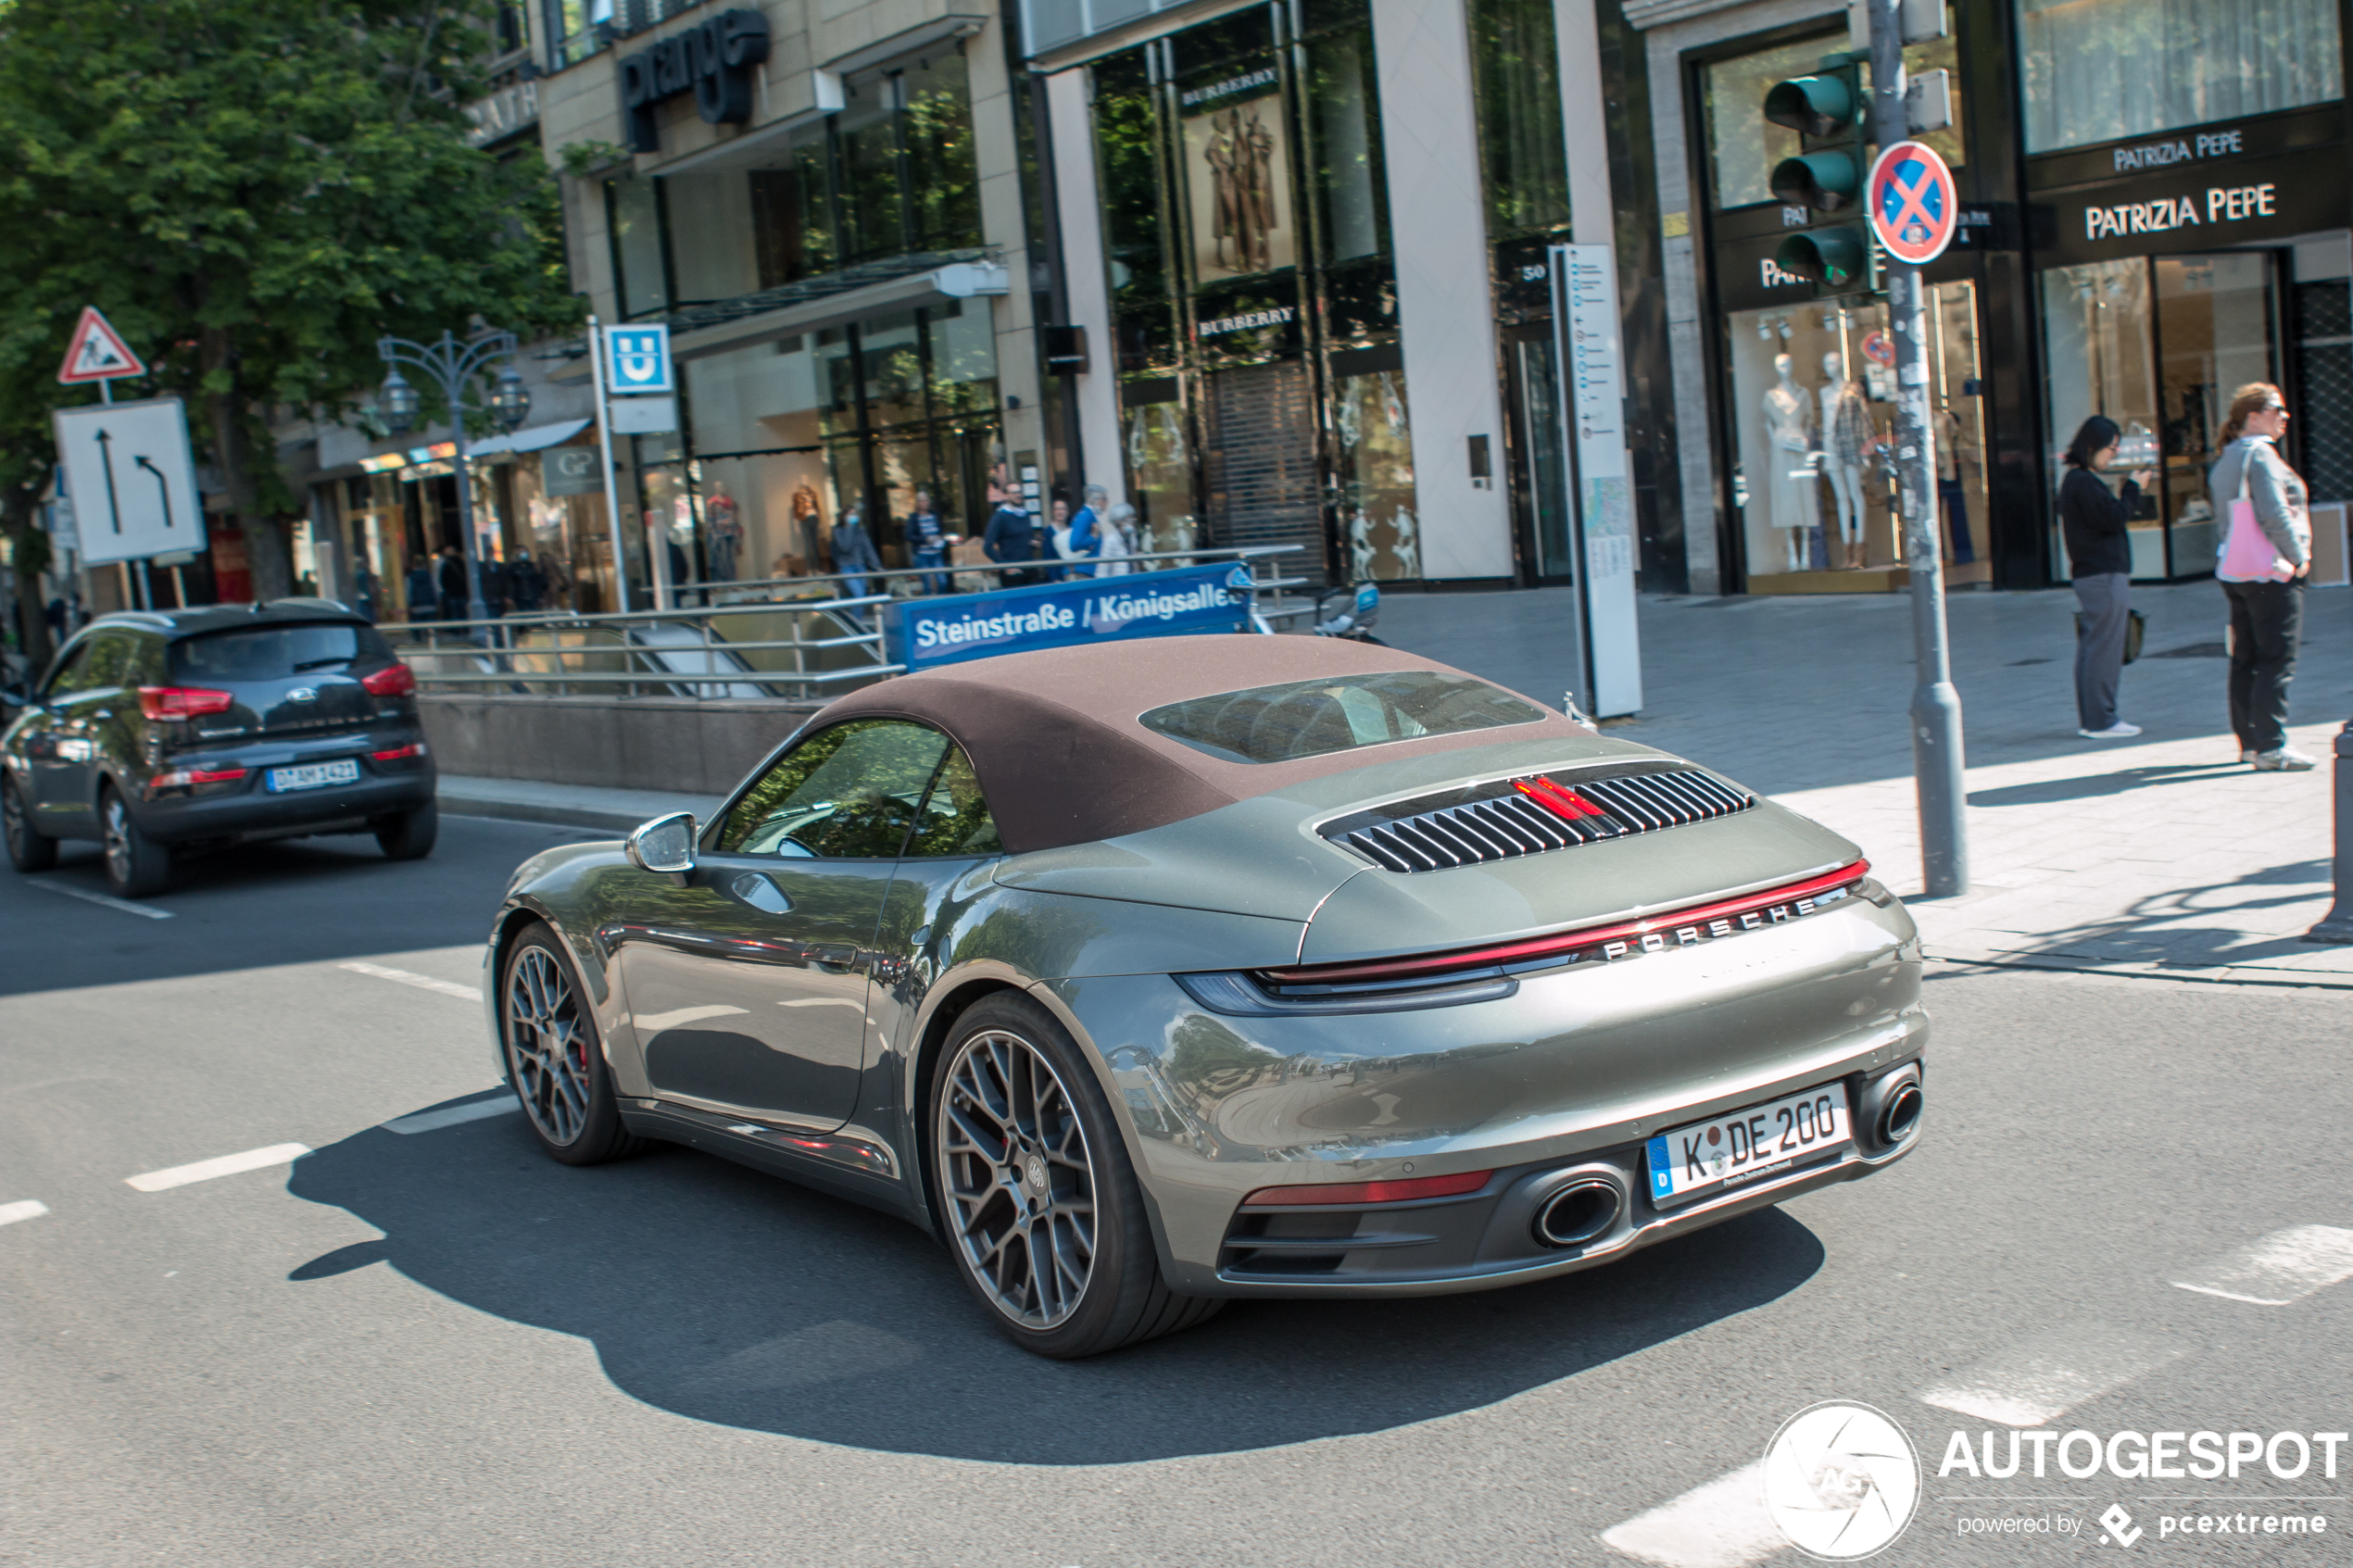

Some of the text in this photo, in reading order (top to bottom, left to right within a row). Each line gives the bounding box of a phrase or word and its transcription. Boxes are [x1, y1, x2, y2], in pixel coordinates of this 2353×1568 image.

[618, 8, 770, 153] prange
[1182, 67, 1277, 107] BURBERRY
[2113, 129, 2243, 171] PATRIZIA PEPE
[2085, 183, 2276, 241] PATRIZIA PEPE
[1522, 264, 1546, 282] 50
[1199, 307, 1295, 335] BURBERRY
[915, 603, 1076, 646] Steinstraße
[1082, 598, 1092, 627] /
[1604, 898, 1815, 960] PORSCHE
[1683, 1095, 1834, 1181] K DE 200
[1657, 1173, 1668, 1188] D
